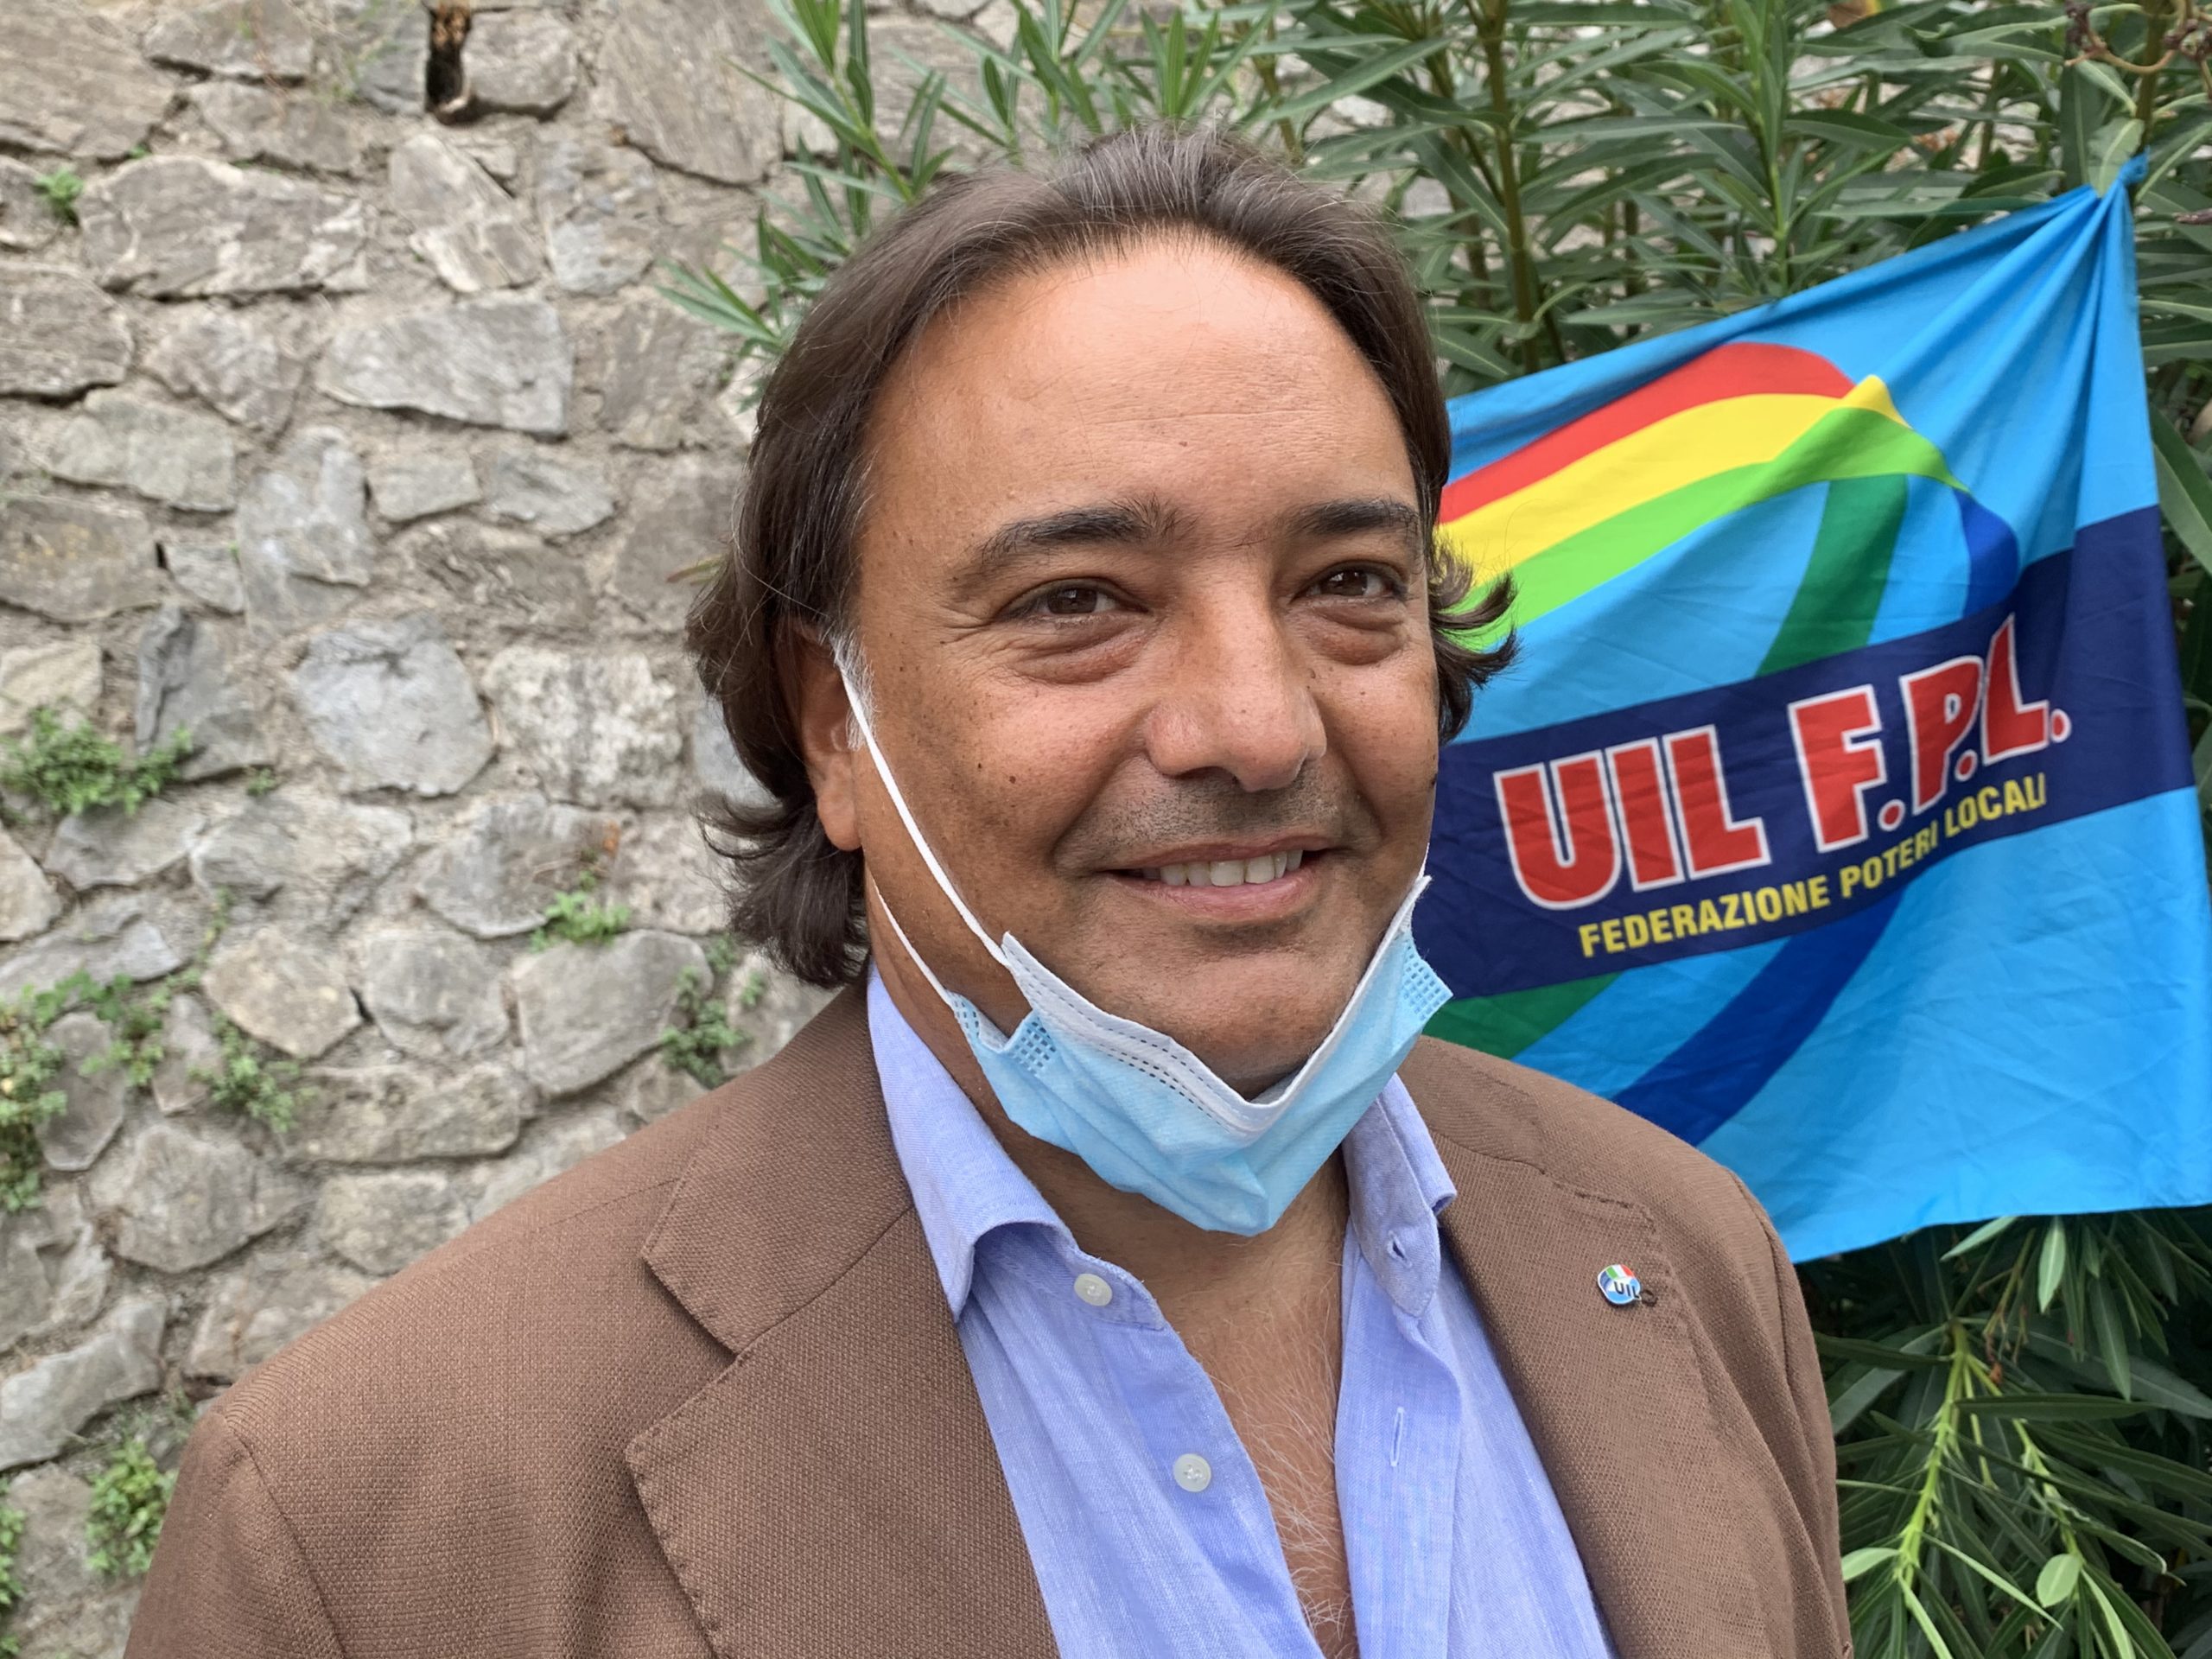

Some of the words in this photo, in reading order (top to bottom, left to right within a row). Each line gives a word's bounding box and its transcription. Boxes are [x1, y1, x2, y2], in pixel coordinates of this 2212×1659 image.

[1493, 725, 1771, 912] UIL
[1789, 613, 2072, 853] F.P.L.
[1579, 874, 1830, 958] FEDERAZIONE
[1840, 827, 1938, 899] POTERI
[1945, 772, 2047, 838] LOCALI
[1614, 1281, 1640, 1299] UIL
